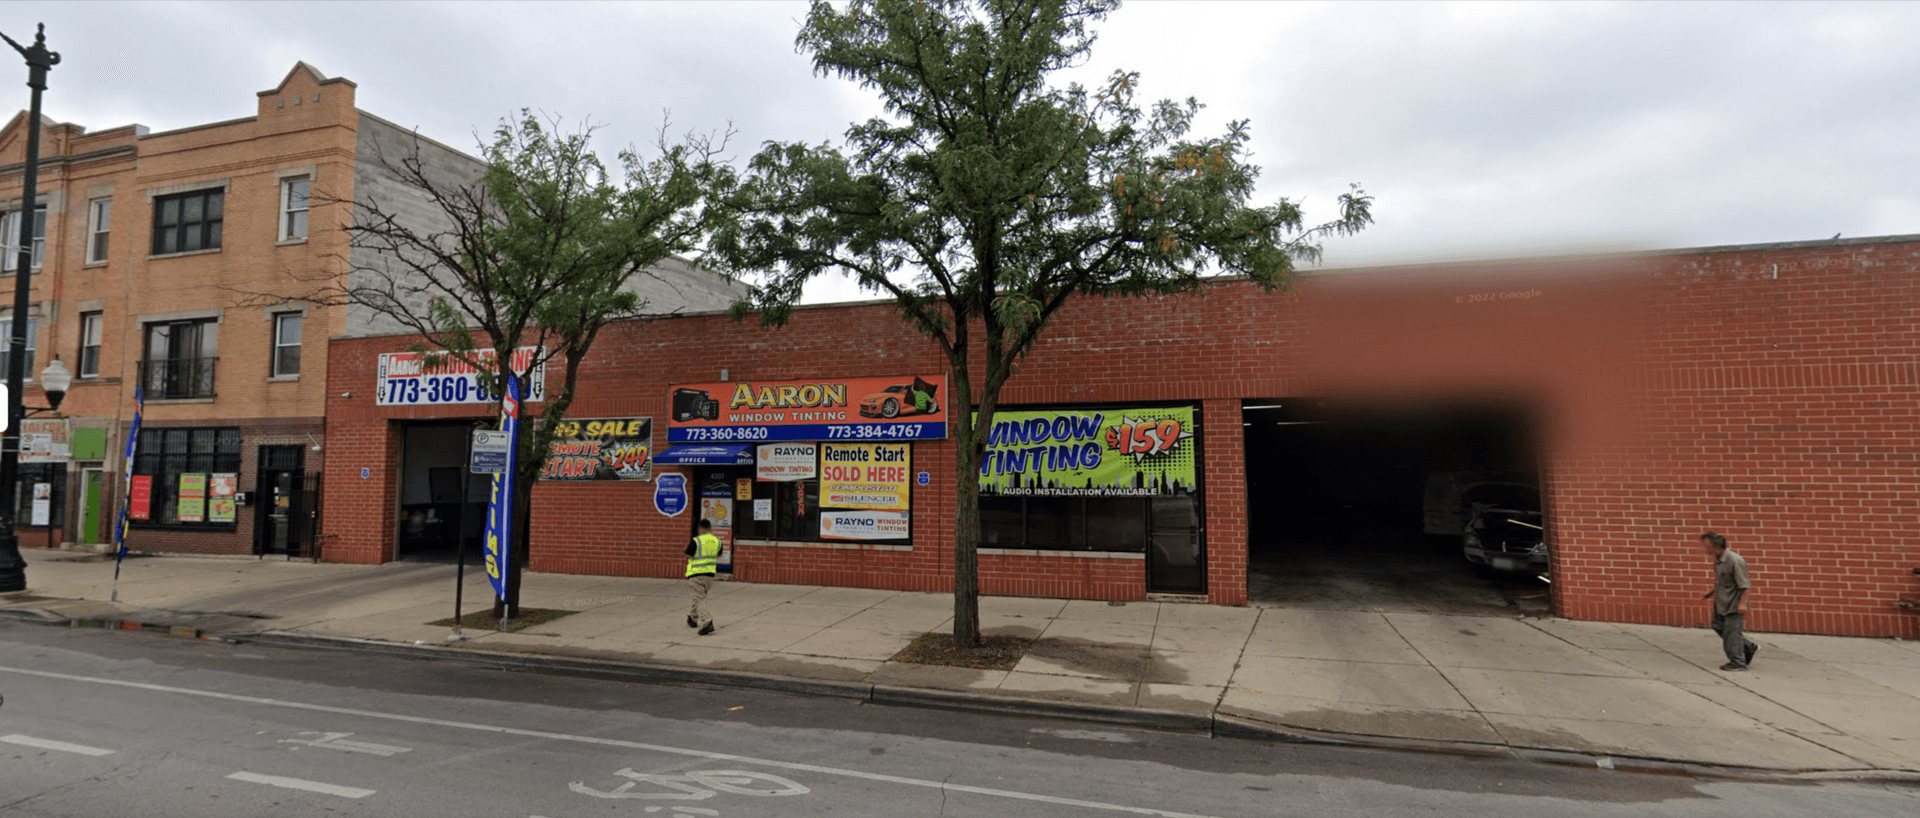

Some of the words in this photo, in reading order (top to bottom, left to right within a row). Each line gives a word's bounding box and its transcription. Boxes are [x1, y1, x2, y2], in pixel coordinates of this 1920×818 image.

[728, 382, 848, 409] AARON
[729, 412, 785, 423] WINDOW
[792, 410, 847, 422] TINTING
[586, 420, 643, 437] SALE
[686, 427, 768, 440] 773-360-8620
[827, 424, 923, 438] 773-384-4767
[1105, 418, 1182, 455] $159
[549, 441, 602, 456] EMOTE
[774, 447, 815, 456] RAYNO
[824, 445, 869, 462] Remote
[874, 445, 905, 462] Start
[605, 445, 648, 470] $249
[758, 465, 786, 473] WINDOW
[788, 465, 814, 473] TINTING
[823, 465, 861, 482] SOLD
[866, 466, 906, 482] HERE
[1003, 487, 1033, 496] AUDIO
[1034, 488, 1102, 496] INSTALLATION
[1104, 487, 1158, 496] AVAILABLE
[835, 517, 875, 526] RAYNO
